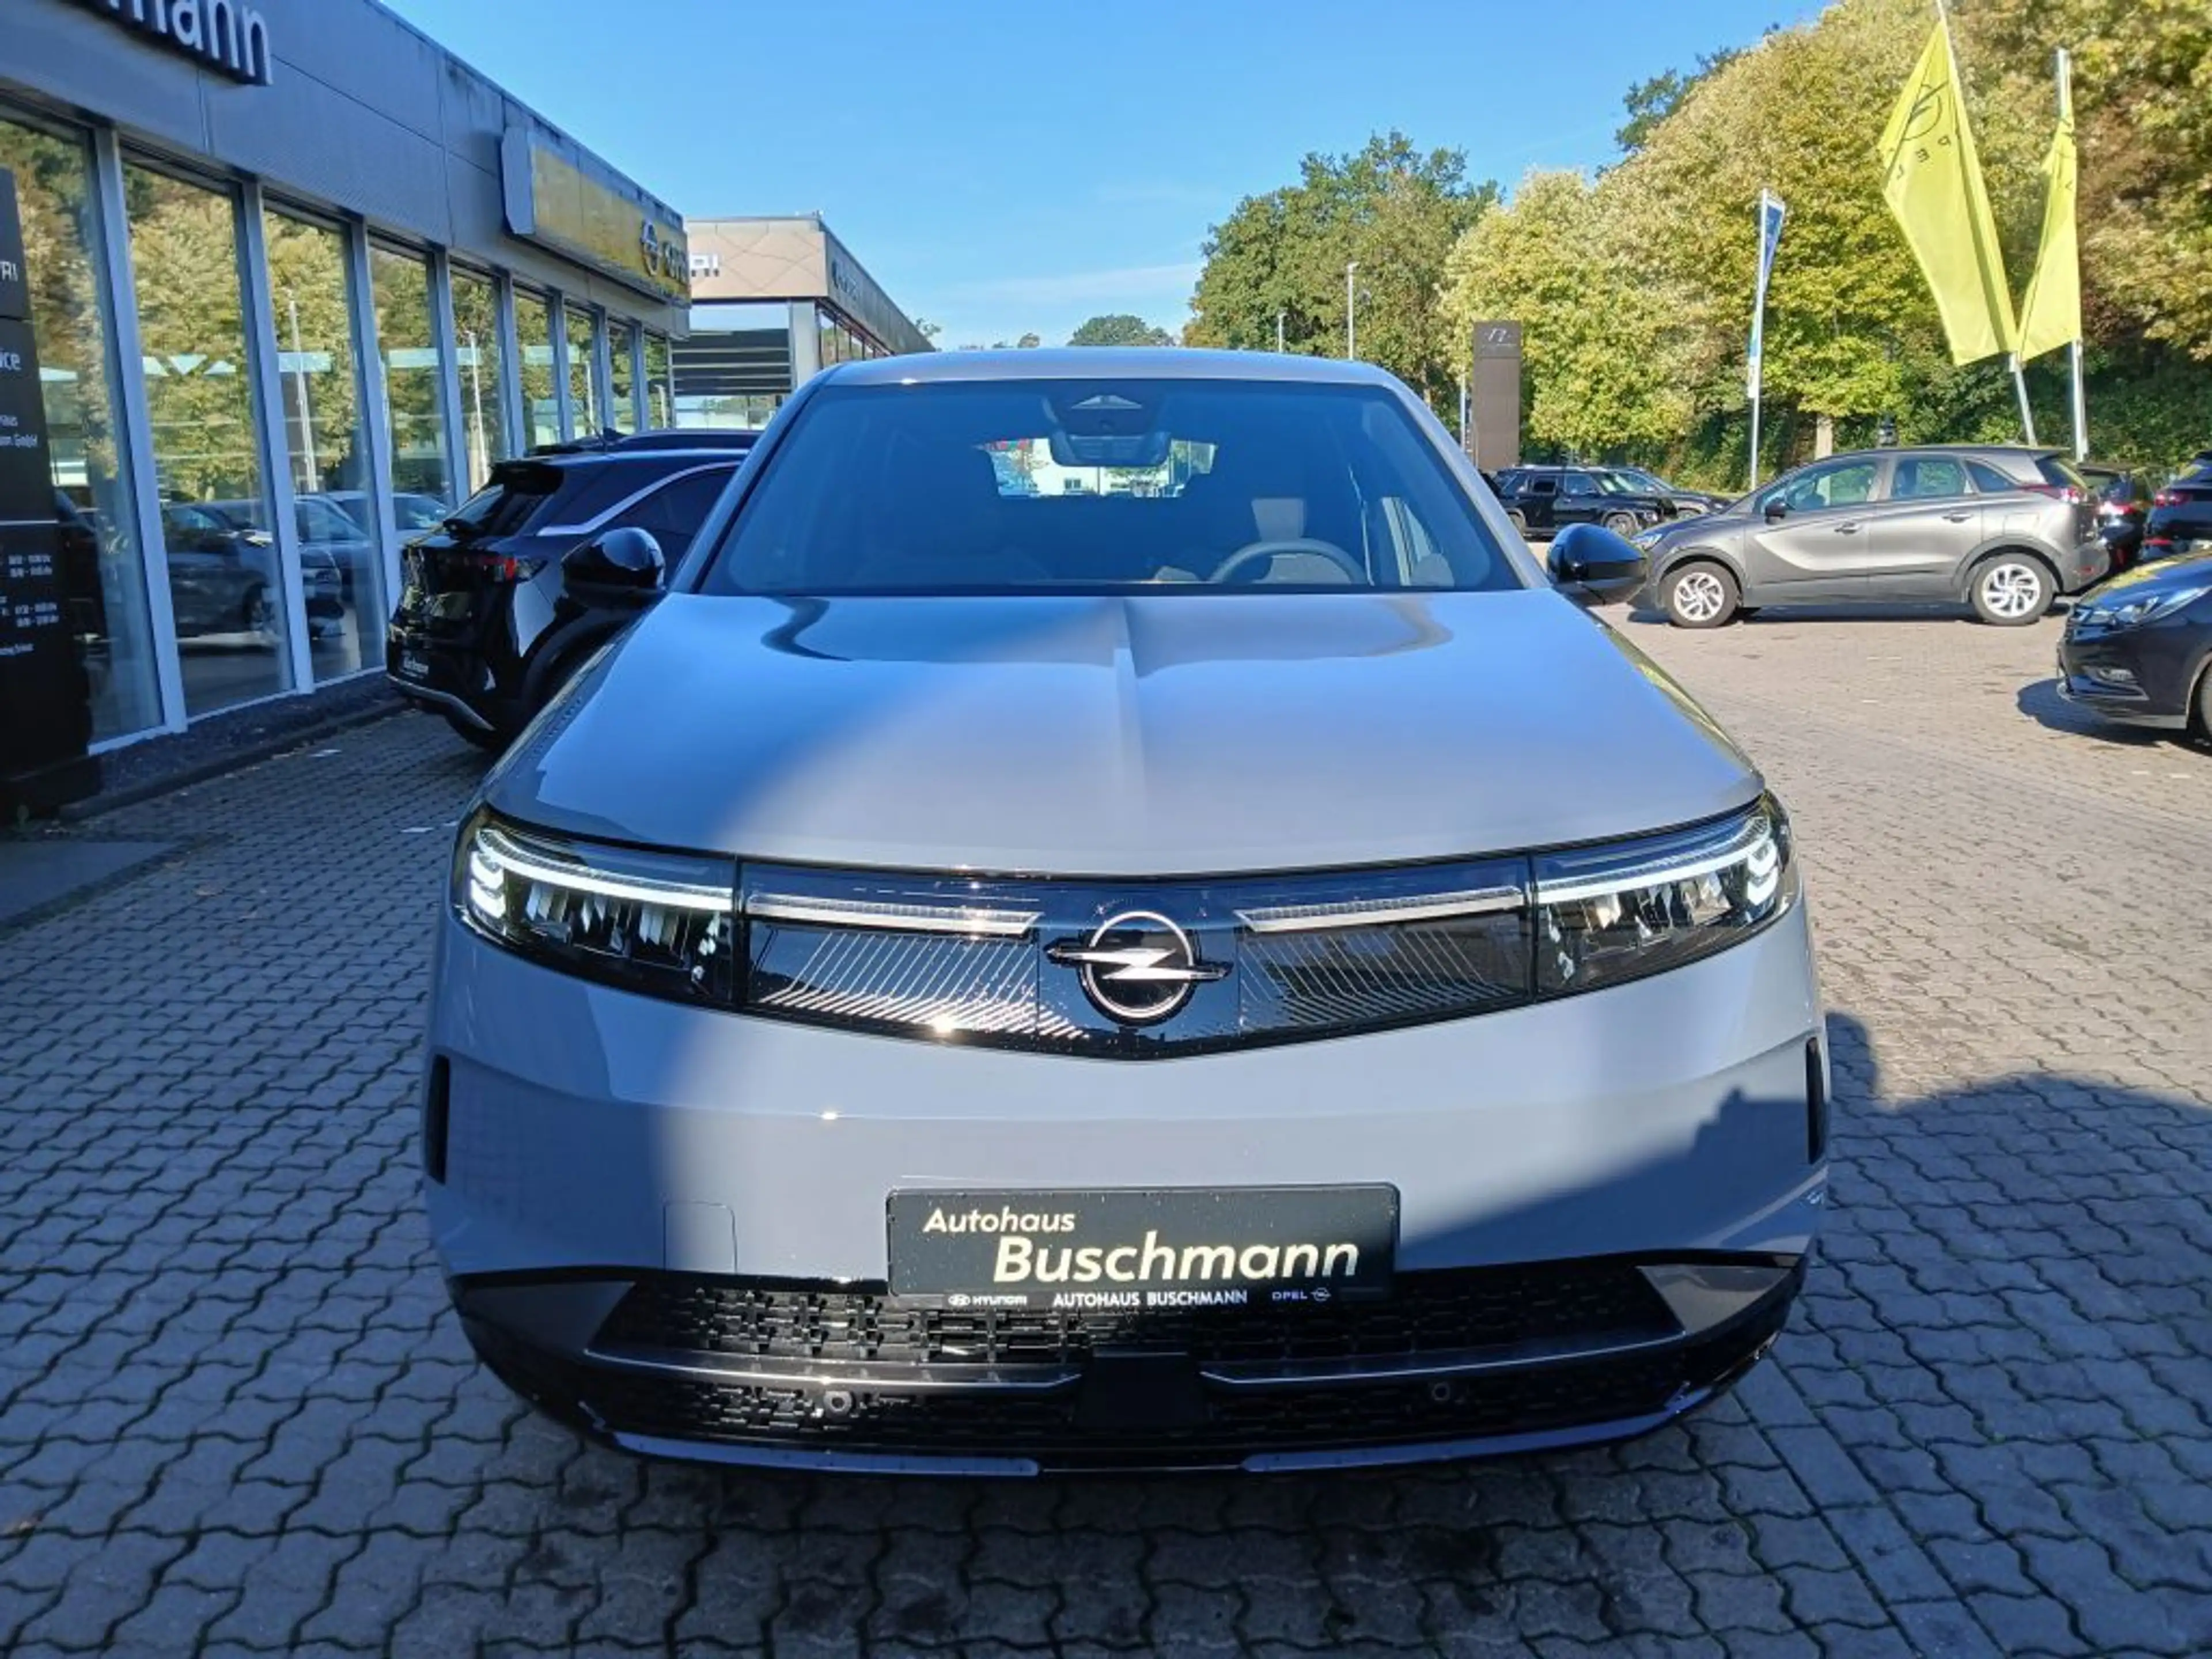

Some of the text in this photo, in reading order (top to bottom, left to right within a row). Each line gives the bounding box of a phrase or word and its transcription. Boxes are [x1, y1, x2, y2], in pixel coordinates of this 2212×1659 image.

[923, 1205, 1076, 1233] Autohaus
[993, 1230, 1359, 1282] Buschmann
[1052, 1290, 1248, 1307] AUTOHAUS BUSCHMANN
[1272, 1291, 1308, 1301] OPEL
